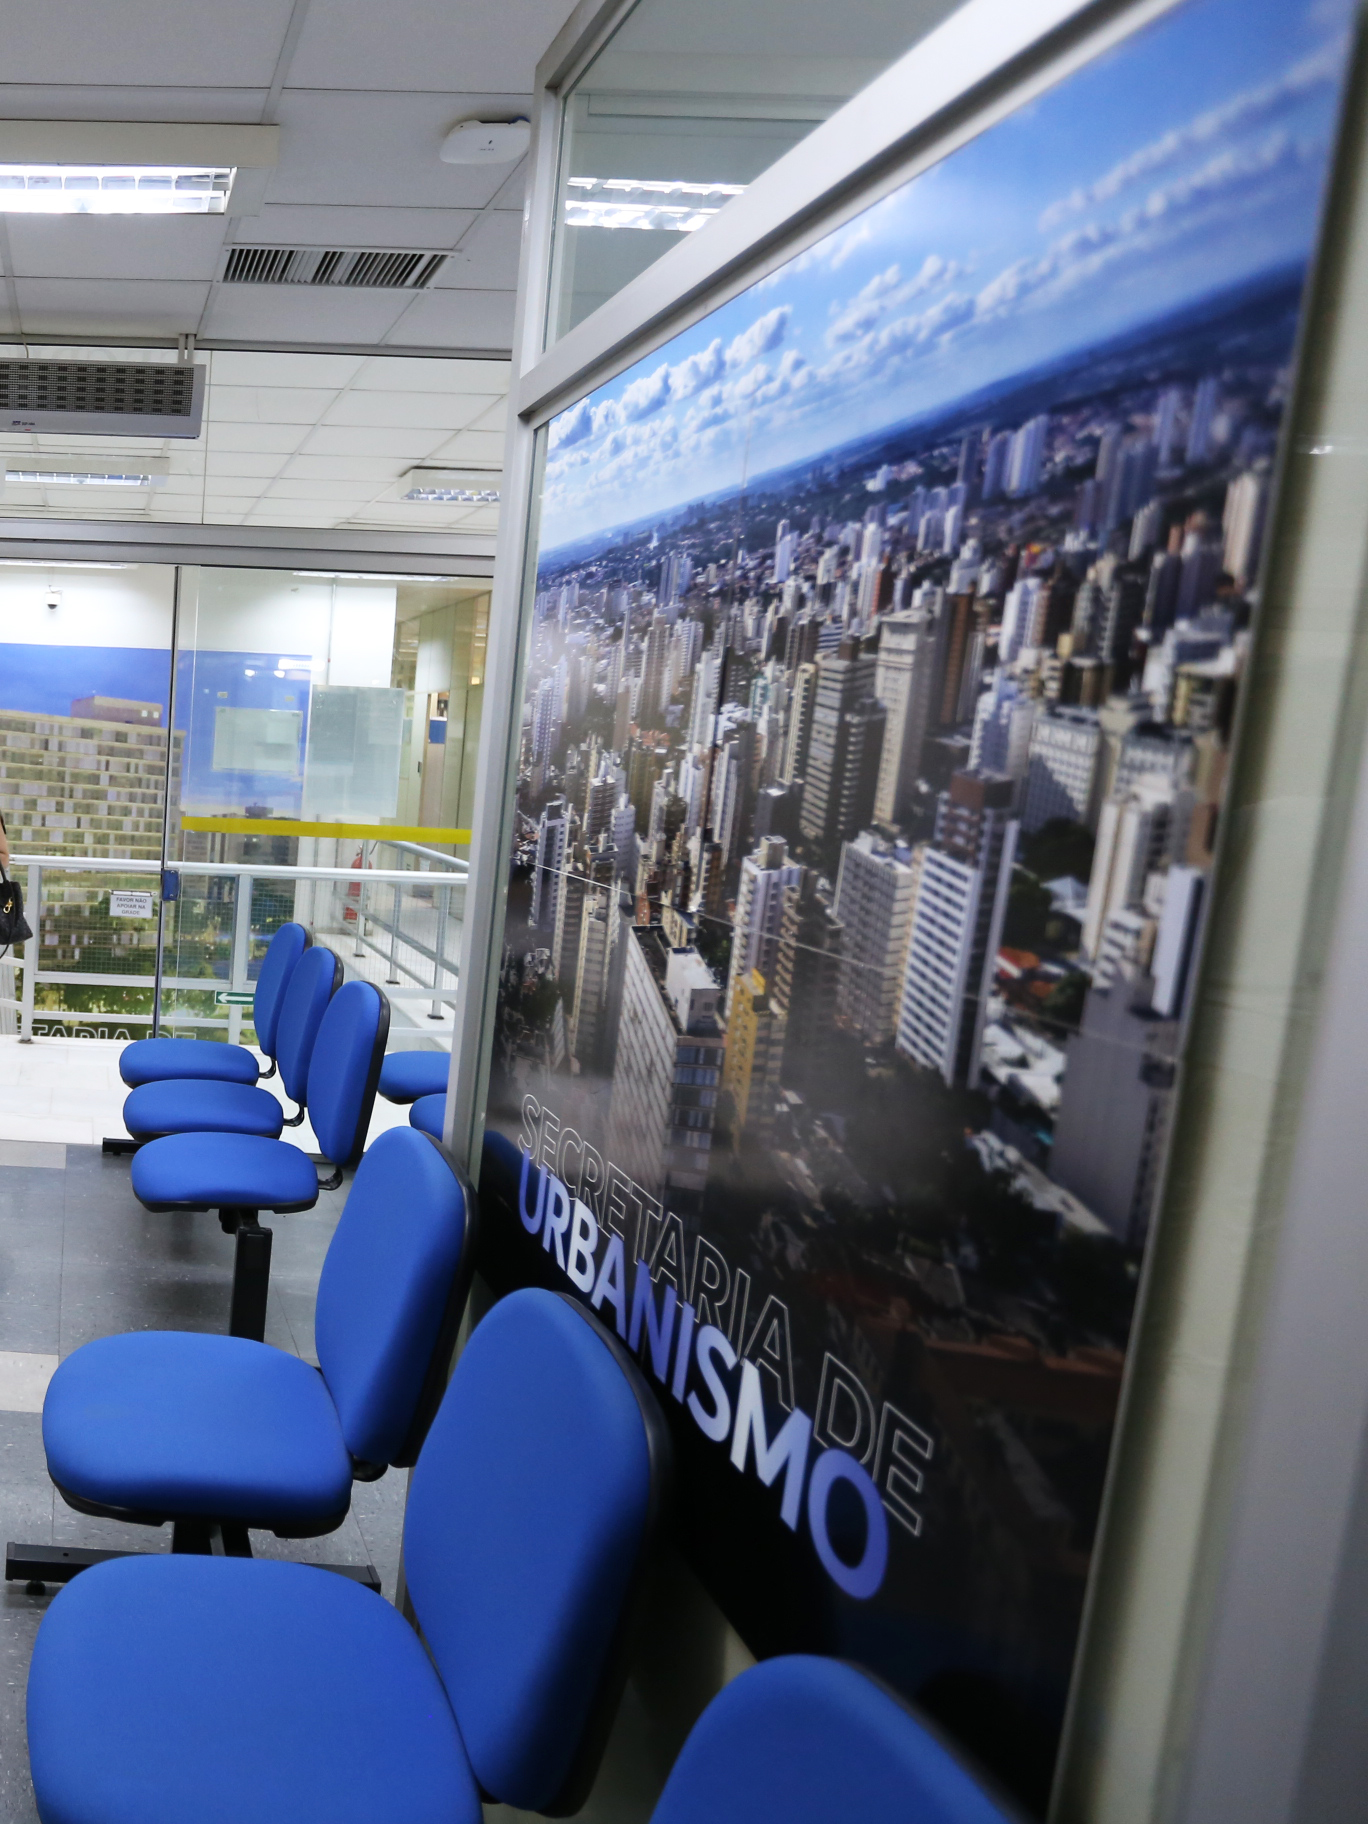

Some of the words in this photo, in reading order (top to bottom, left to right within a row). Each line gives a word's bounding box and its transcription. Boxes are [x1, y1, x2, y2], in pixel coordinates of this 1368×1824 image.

[518, 1094, 795, 1412] SECRETARIA
[813, 1352, 933, 1536] DE
[518, 1148, 889, 1599] URBANISMO
